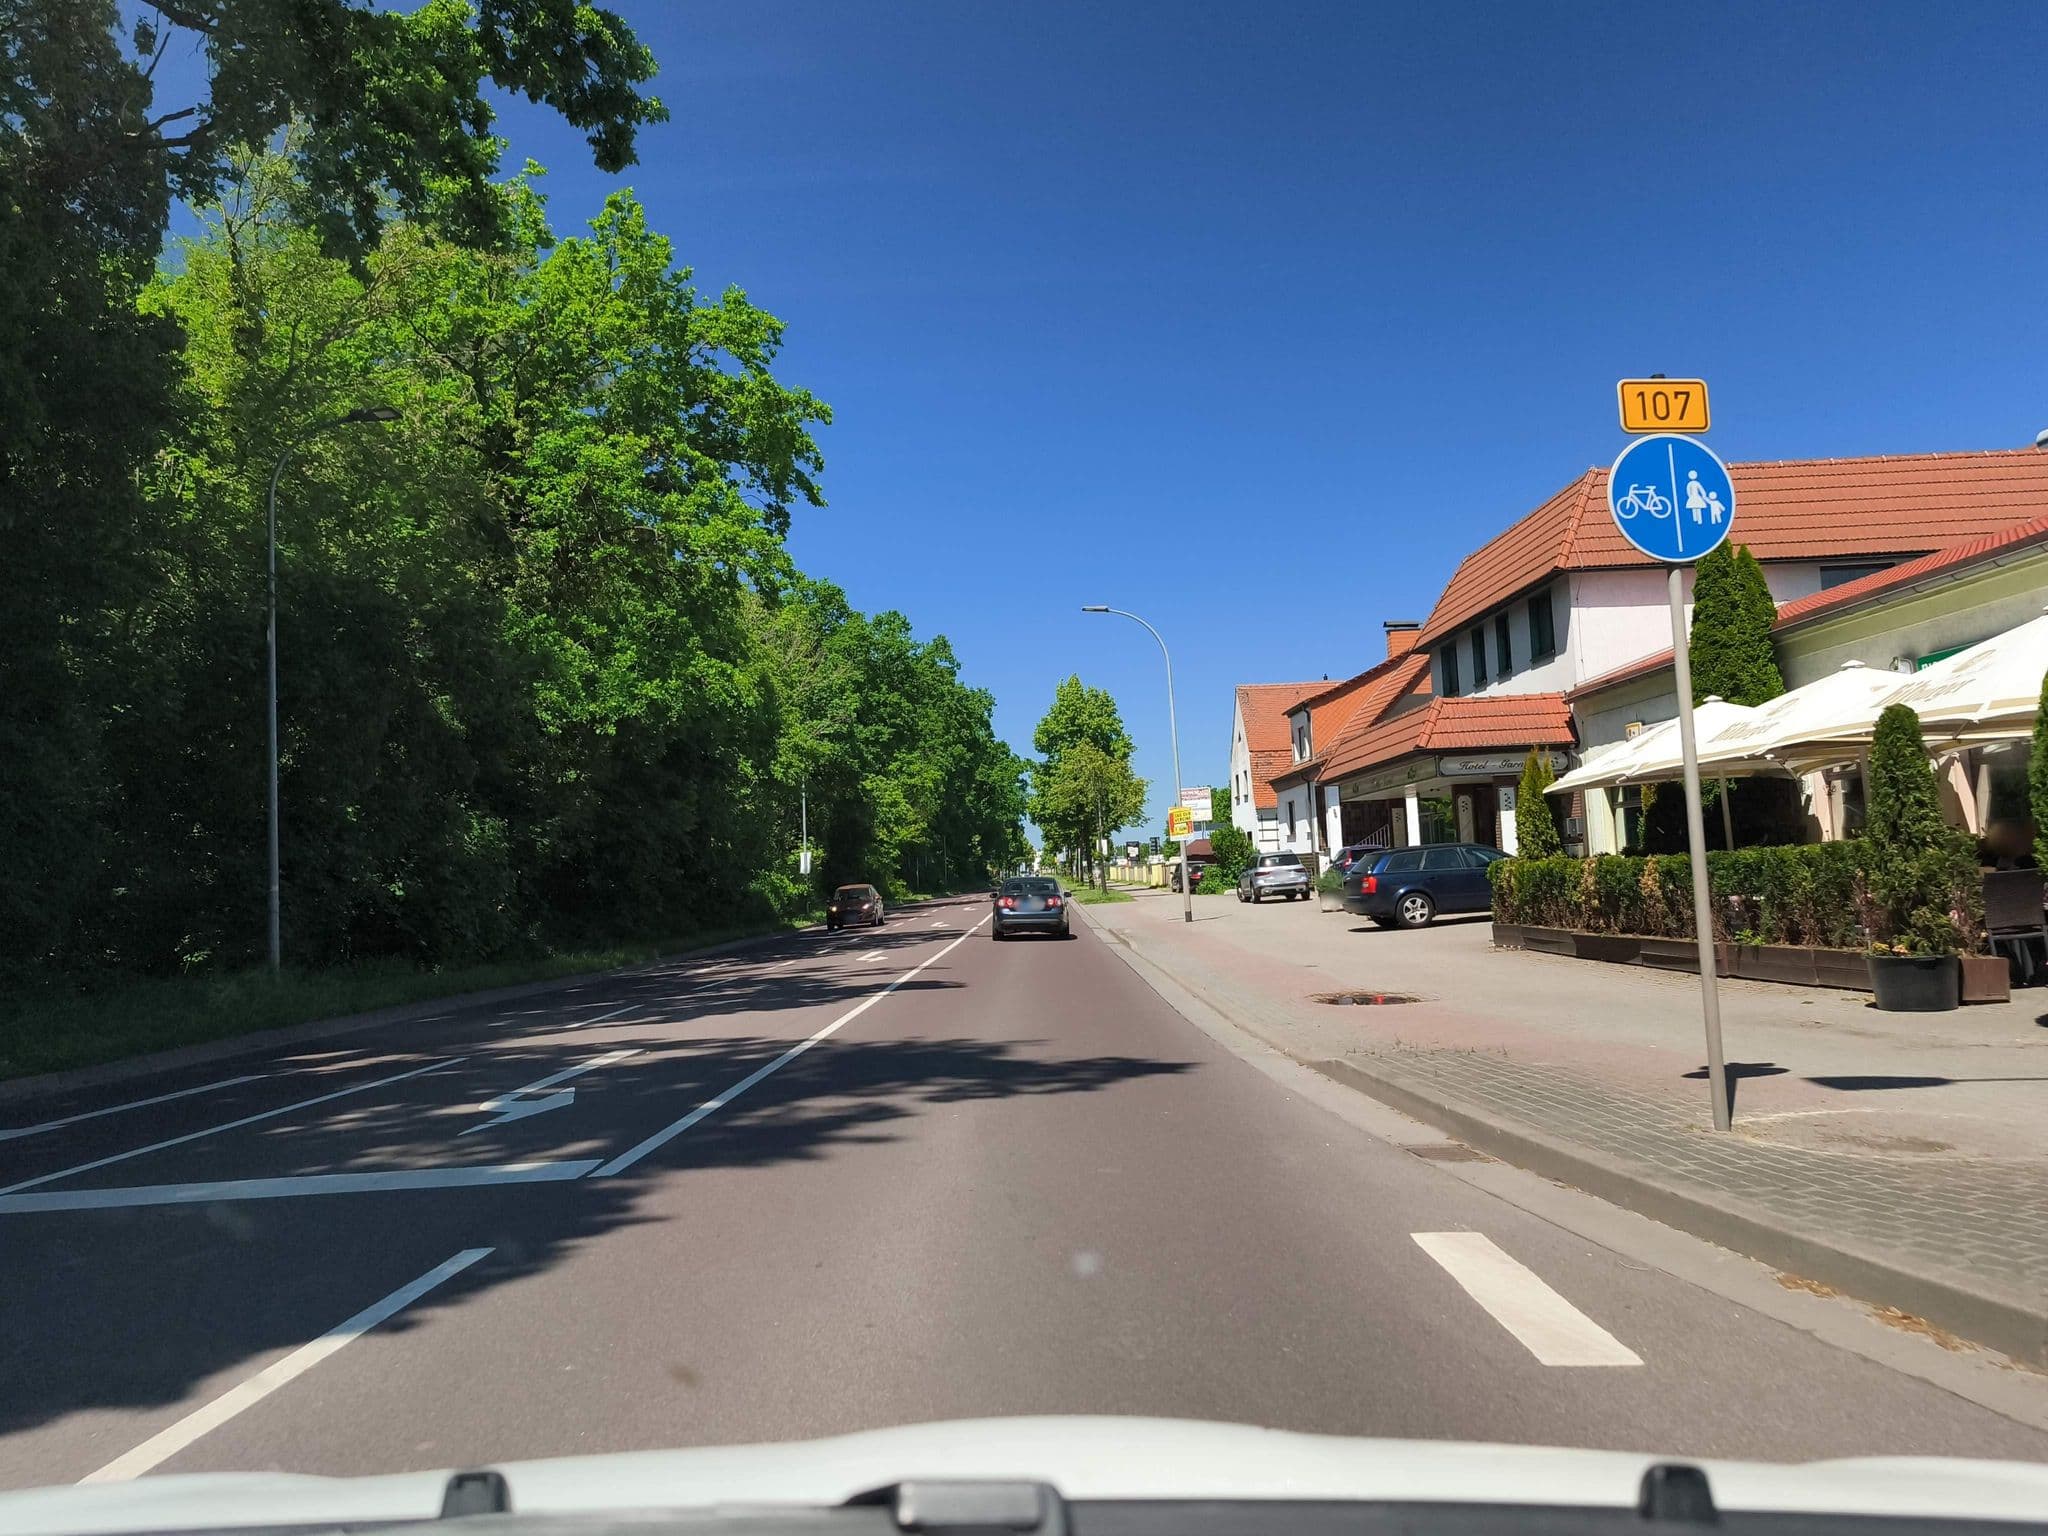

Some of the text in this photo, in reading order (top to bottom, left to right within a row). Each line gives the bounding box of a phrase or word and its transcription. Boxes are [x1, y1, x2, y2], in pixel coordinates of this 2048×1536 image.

[1636, 391, 1690, 421] 107
[1459, 759, 1488, 770] Hotel
[1499, 759, 1524, 769] Garn
